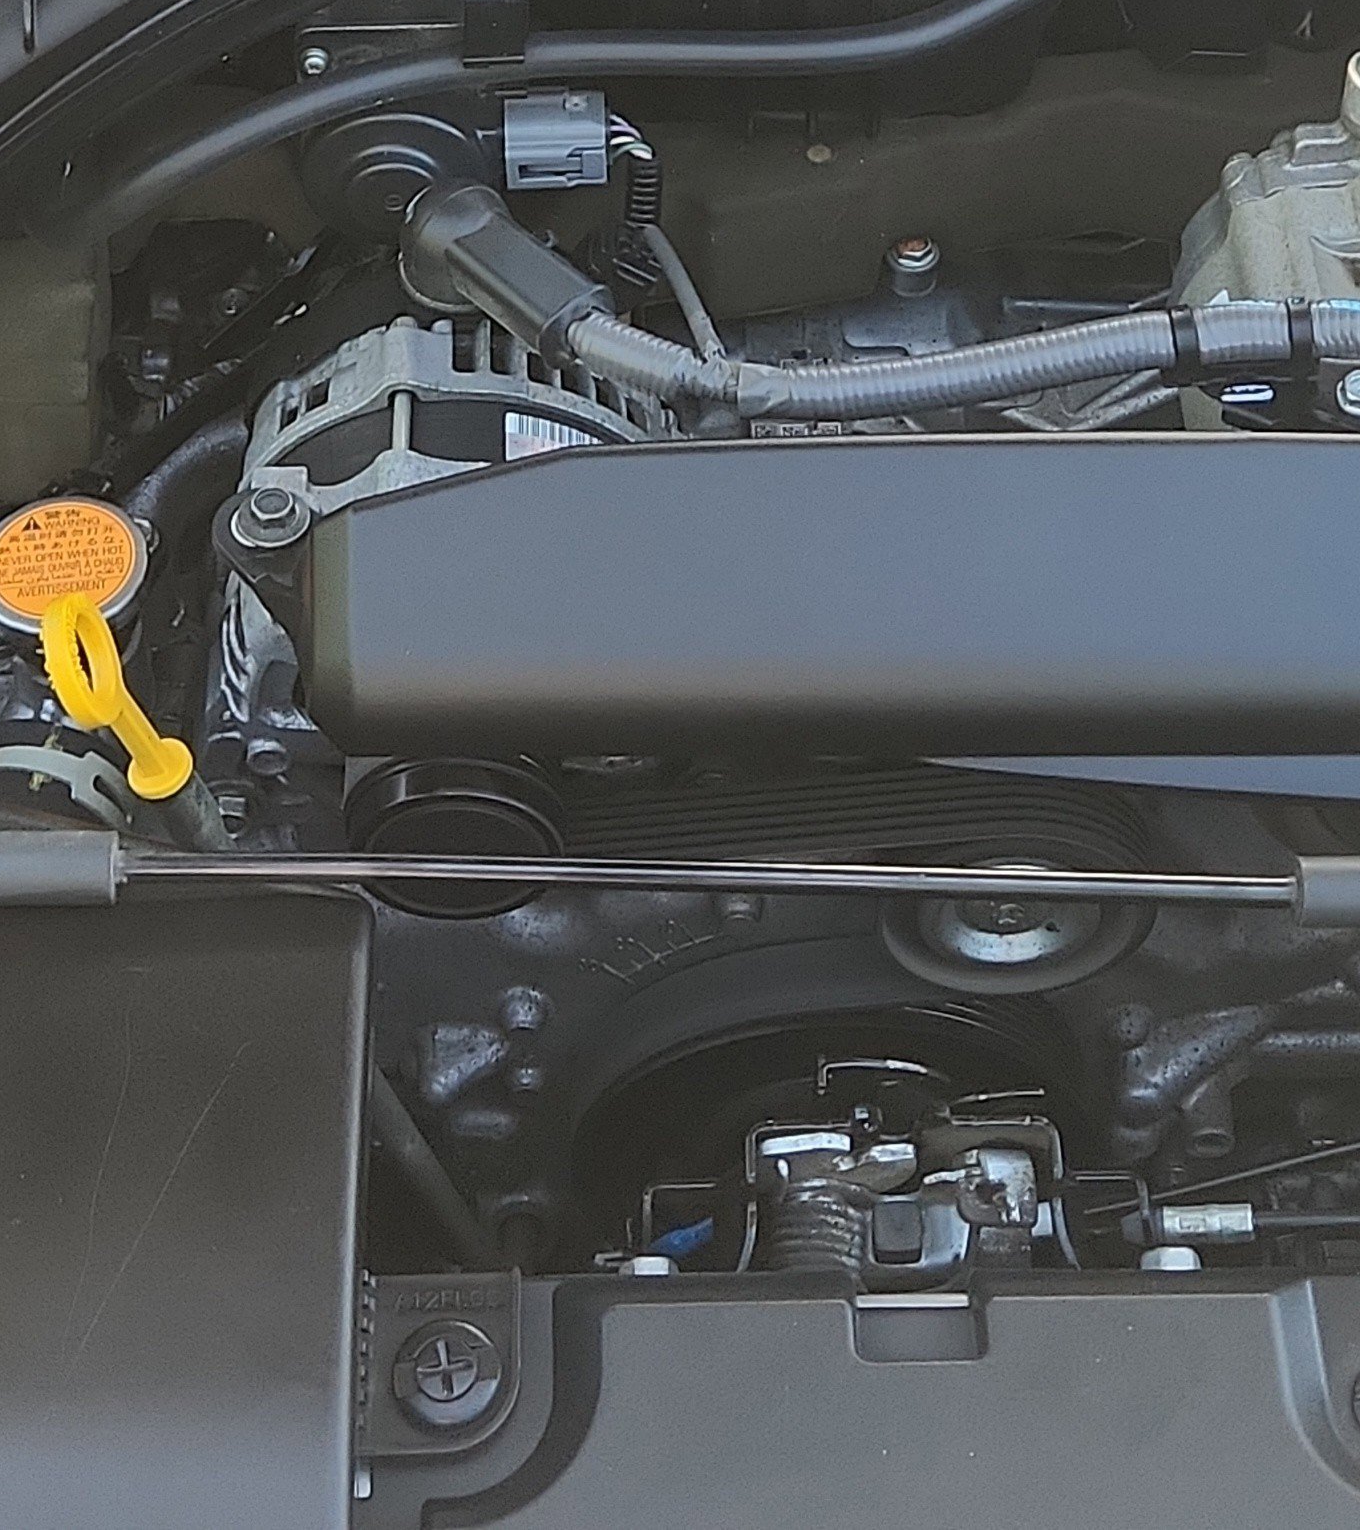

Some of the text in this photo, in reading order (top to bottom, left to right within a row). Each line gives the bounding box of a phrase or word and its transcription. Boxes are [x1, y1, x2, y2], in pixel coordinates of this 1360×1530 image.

[44, 518, 101, 531] WARNING
[35, 551, 64, 564] OPEN
[67, 547, 100, 561] WHEN
[13, 564, 45, 576] JAMAIS
[48, 559, 81, 573] OUVRIR
[17, 577, 106, 598] AVERTISSEMENT
